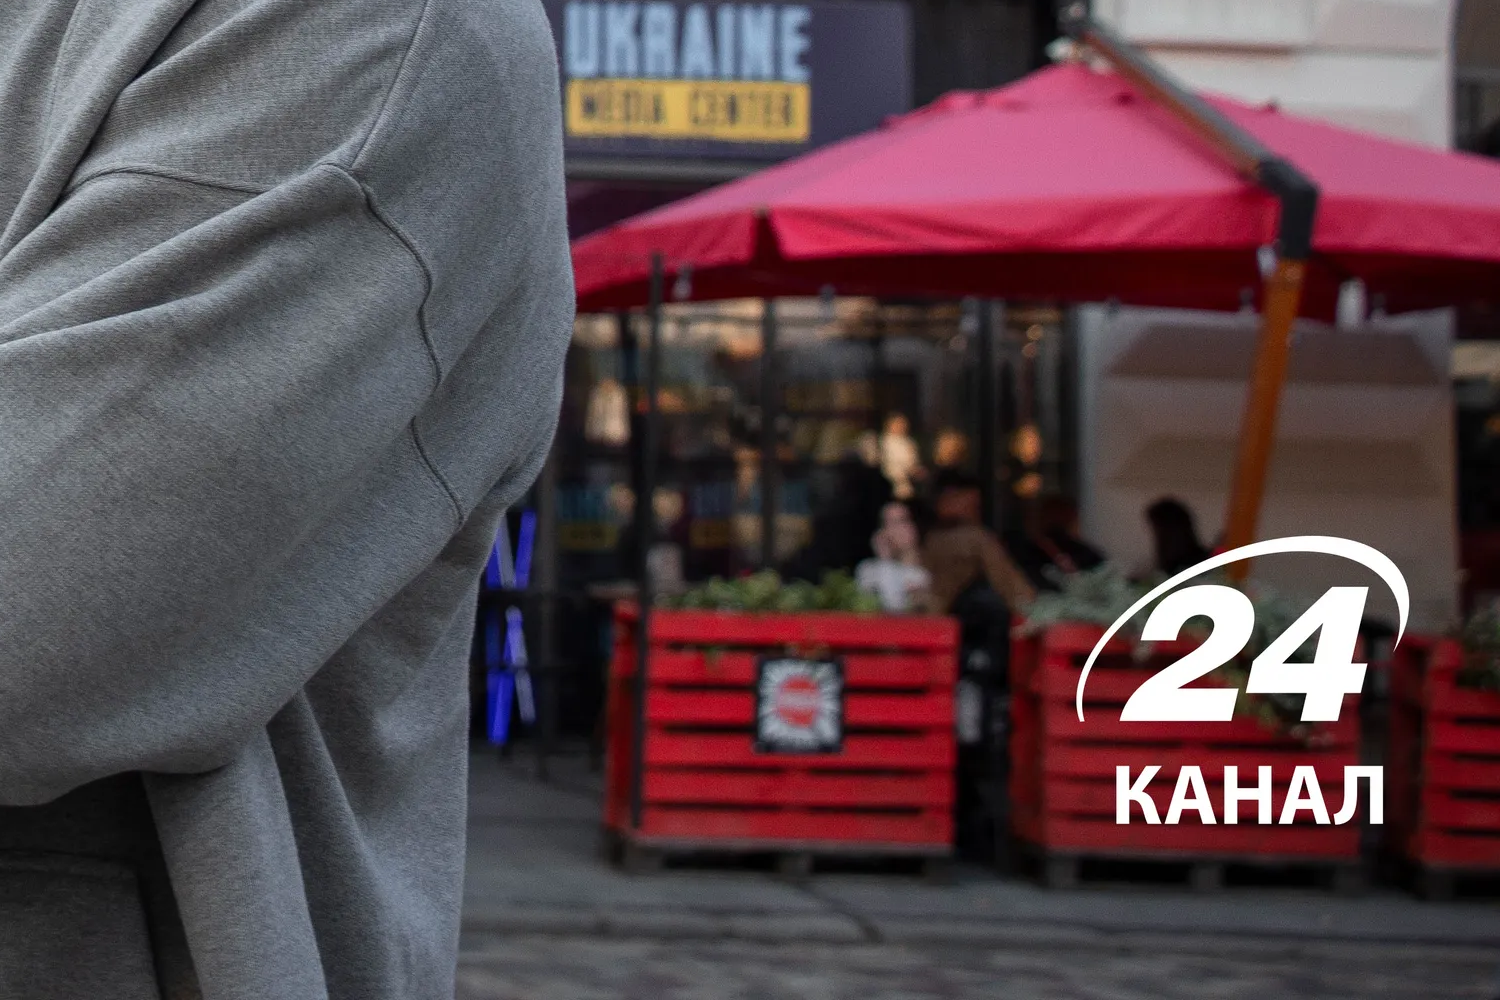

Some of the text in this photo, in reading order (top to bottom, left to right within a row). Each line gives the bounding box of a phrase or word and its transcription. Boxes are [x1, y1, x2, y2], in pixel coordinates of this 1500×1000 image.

[565, 0, 812, 82] UKRAINE
[582, 86, 797, 128] MEDIA CENTER
